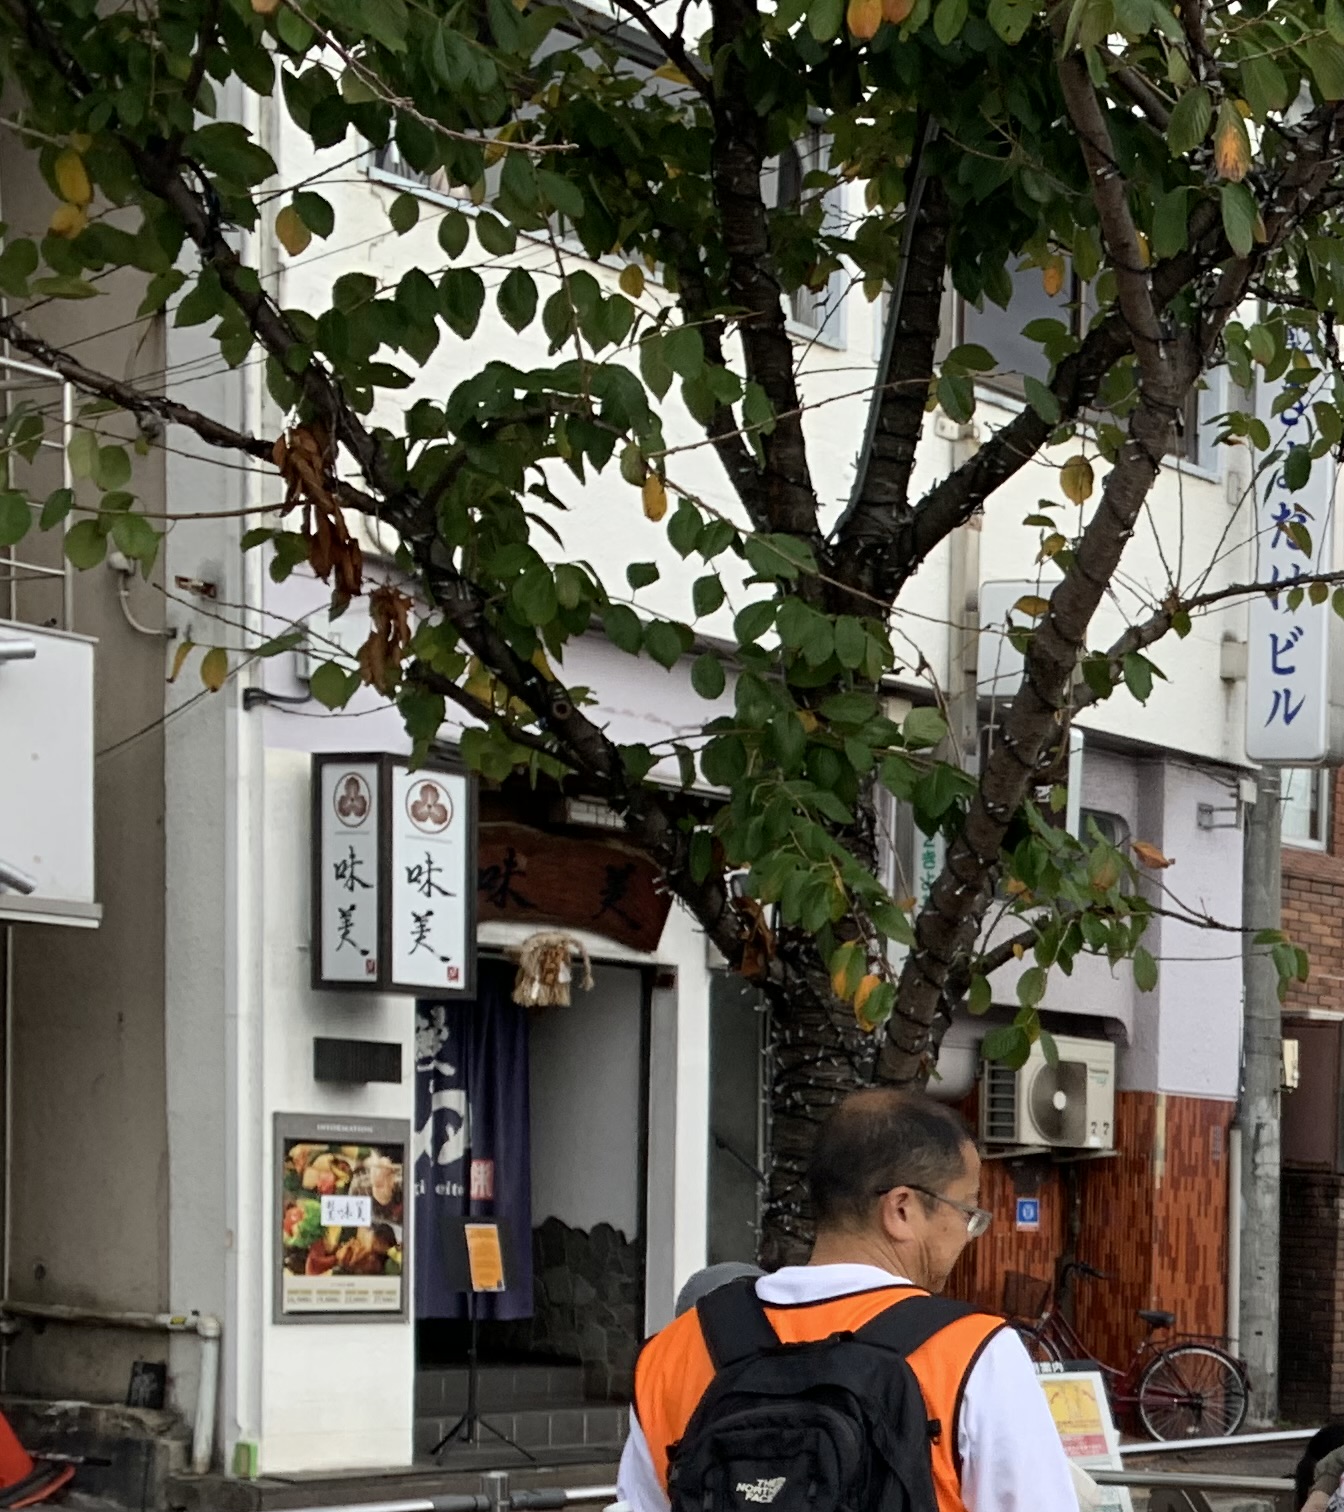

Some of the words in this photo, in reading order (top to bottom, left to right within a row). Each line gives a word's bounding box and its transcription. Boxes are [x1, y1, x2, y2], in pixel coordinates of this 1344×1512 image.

[333, 845, 374, 956] 味美
[405, 851, 457, 962] 味美
[735, 1482, 778, 1495] NORTH
[745, 1491, 773, 1504] FACE
